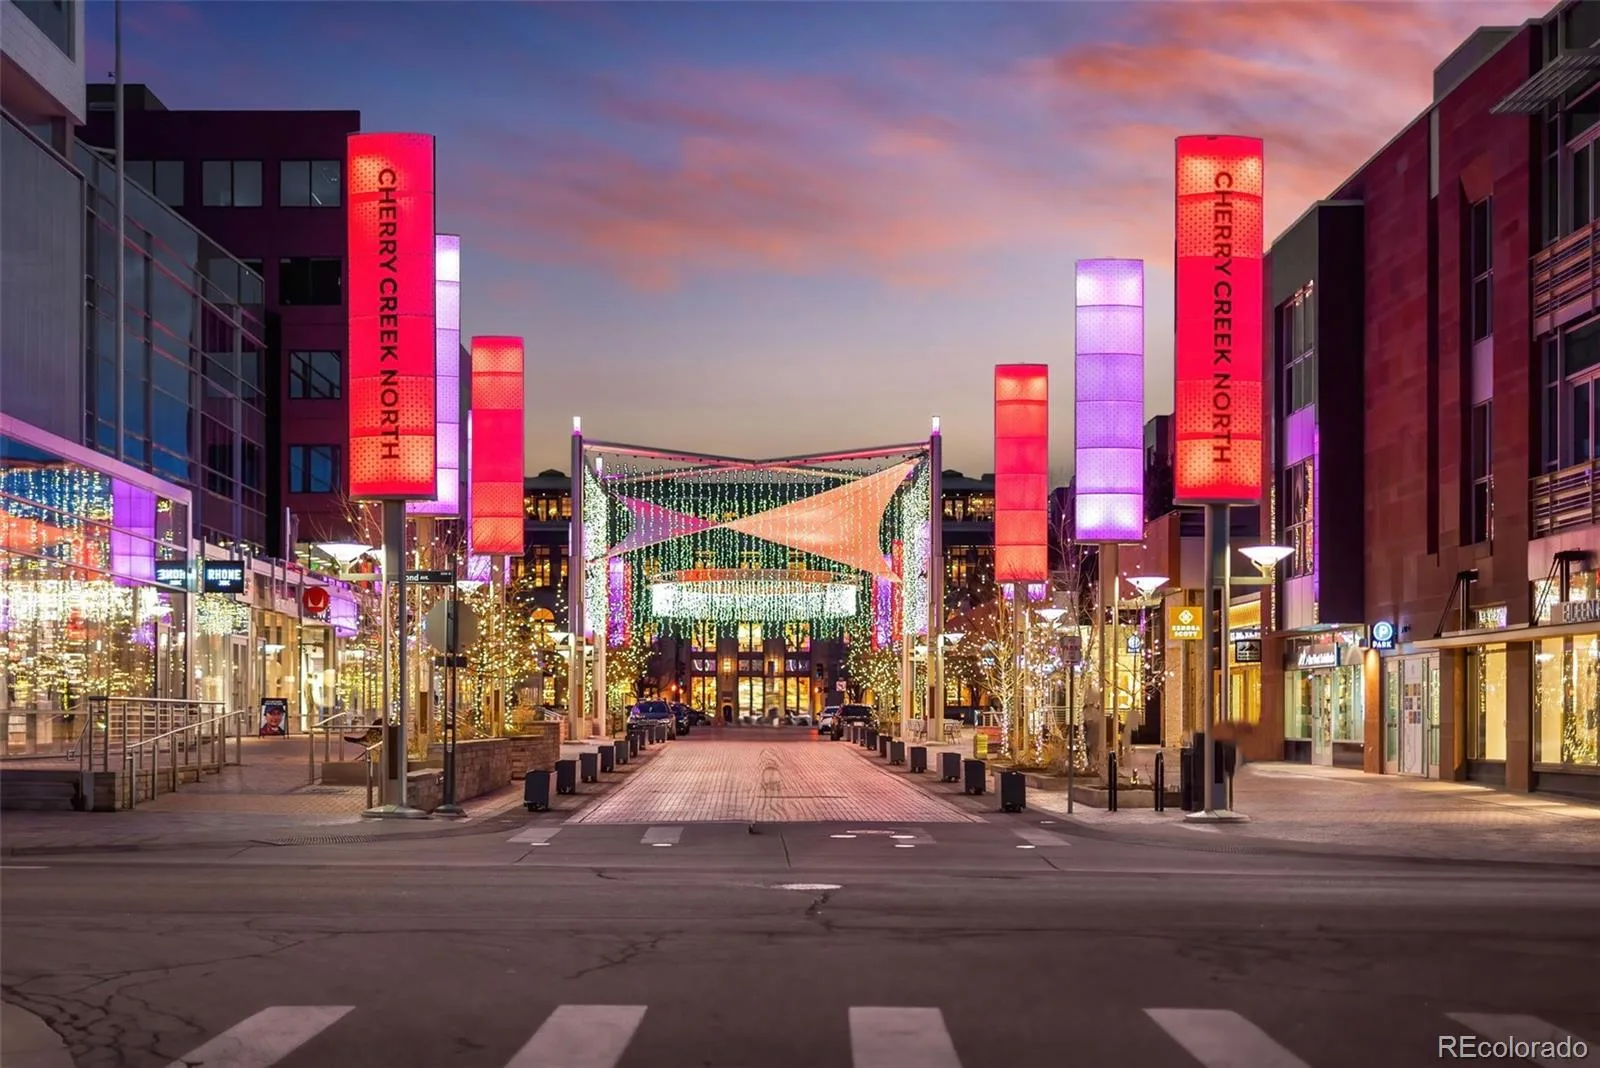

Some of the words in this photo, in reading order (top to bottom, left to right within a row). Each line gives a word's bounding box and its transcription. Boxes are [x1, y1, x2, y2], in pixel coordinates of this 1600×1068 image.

[377, 168, 398, 273] CHERRY
[1214, 171, 1234, 276] CHERRY
[379, 278, 399, 362] CREEK
[1213, 283, 1233, 364] CREEK
[380, 370, 400, 460] NORTH
[1212, 373, 1232, 463] NORTH
[206, 569, 242, 580] RHONE
[1372, 640, 1392, 648] PARK
